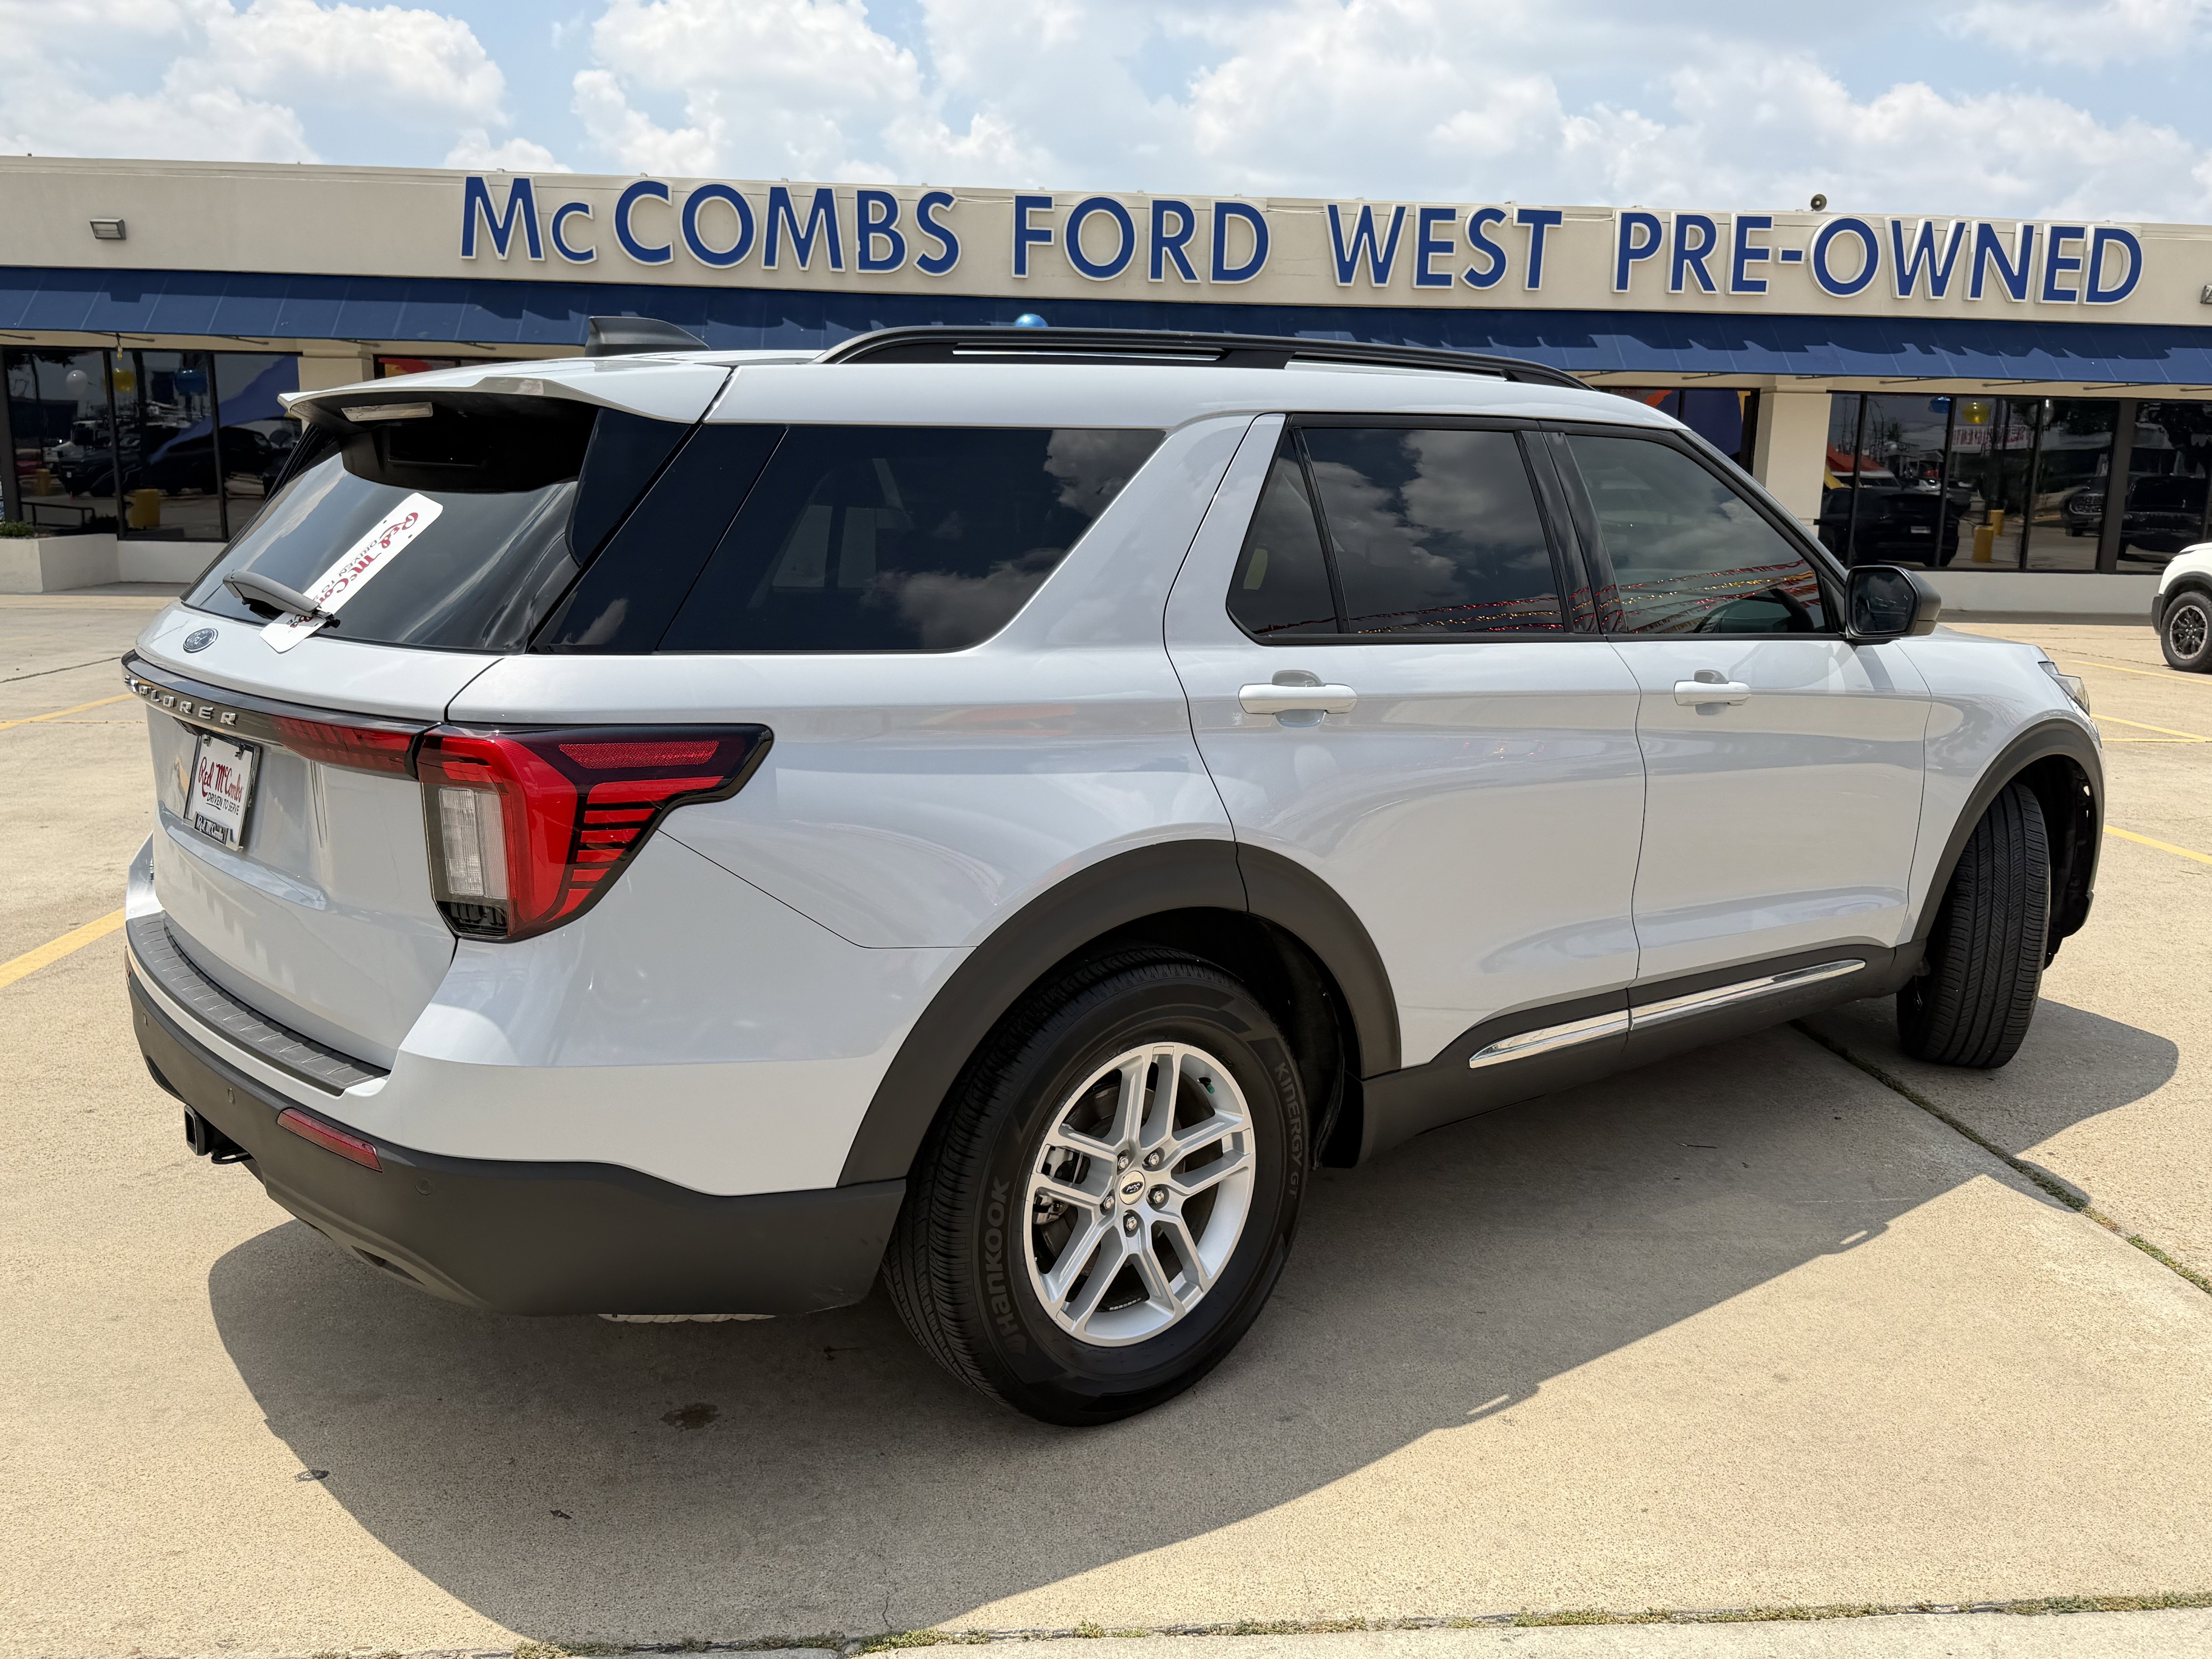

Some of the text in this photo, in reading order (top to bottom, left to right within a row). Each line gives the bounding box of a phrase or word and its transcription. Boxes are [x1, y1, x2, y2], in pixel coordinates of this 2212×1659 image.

[1015, 196, 1268, 281] FORD
[1328, 205, 1563, 288] WEST
[1616, 213, 2142, 302] PRE-OWNED
[290, 512, 419, 628] Red McCobs
[338, 539, 378, 577] DRIVEN
[321, 580, 338, 593] TO
[198, 756, 215, 798] Red
[206, 792, 223, 808] DRIVEN
[223, 798, 229, 810] TO
[1289, 1171, 1299, 1199] GT
